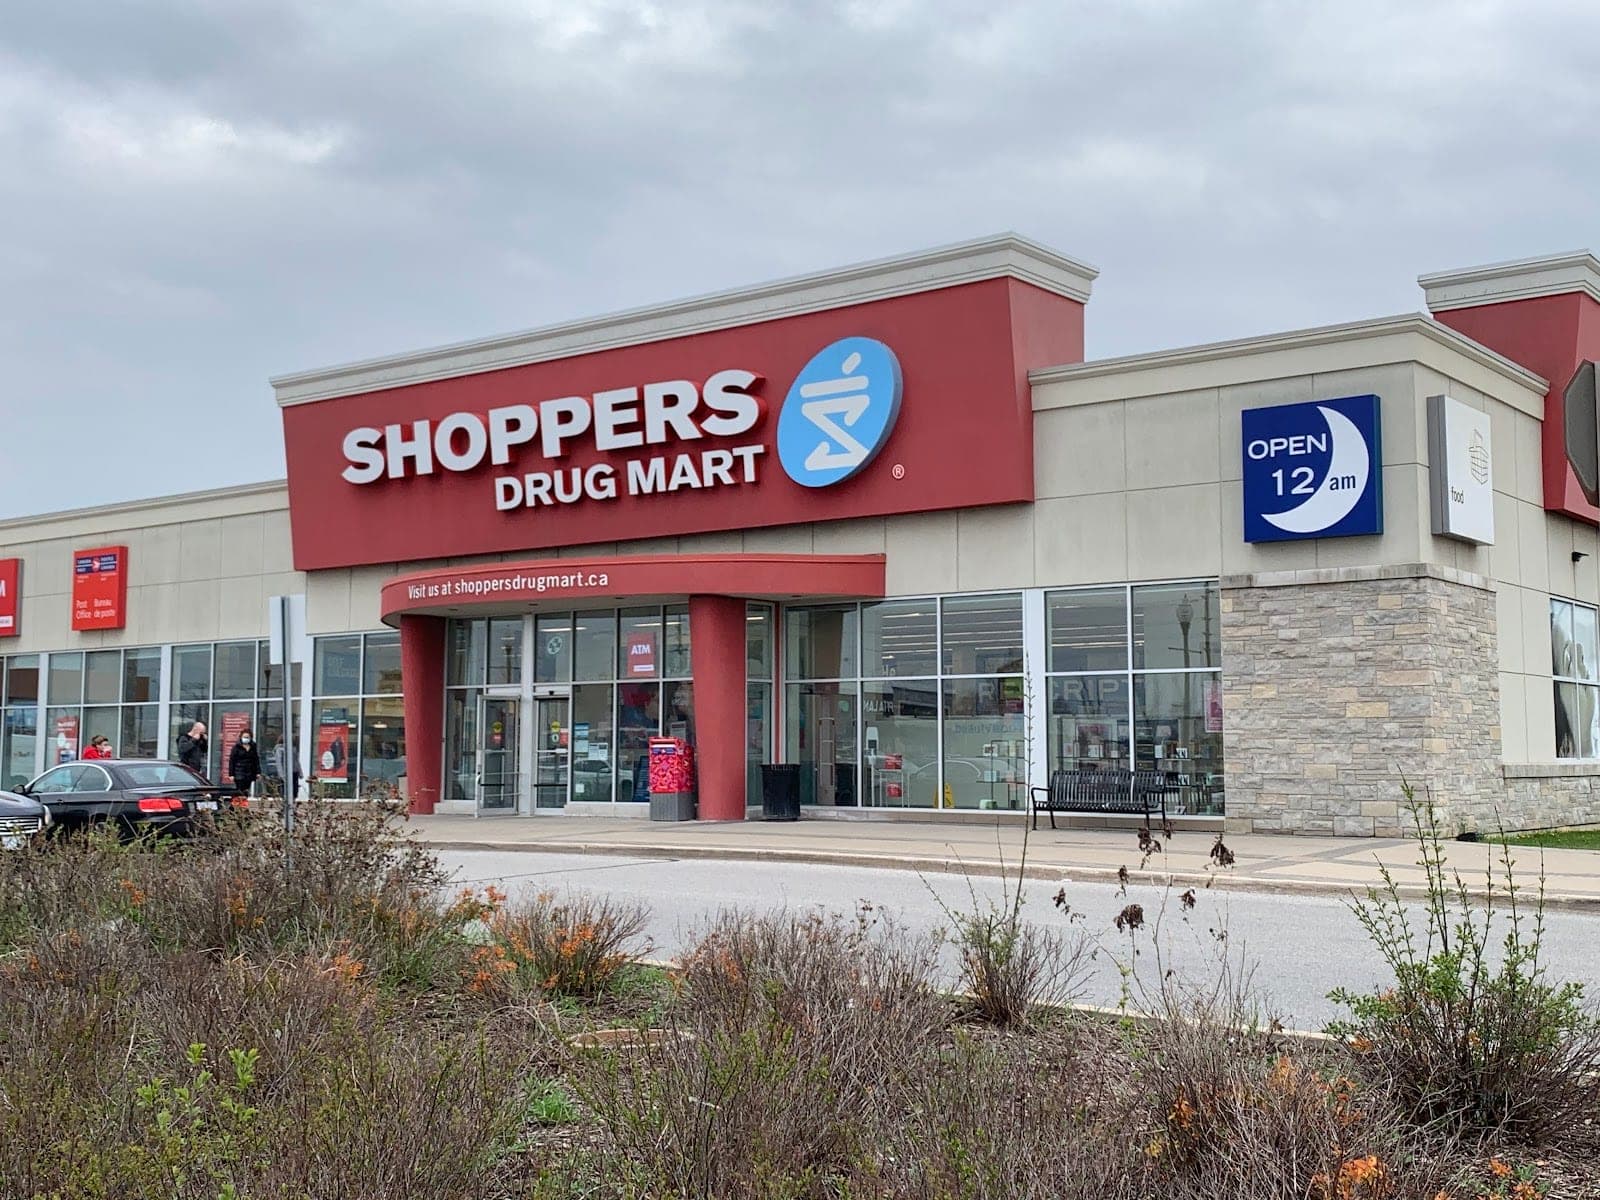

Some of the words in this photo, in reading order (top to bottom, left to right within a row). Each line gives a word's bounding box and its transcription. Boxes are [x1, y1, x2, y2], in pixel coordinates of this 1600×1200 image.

[341, 369, 759, 485] SHOPPERS
[1248, 433, 1326, 460] OPEN
[495, 463, 617, 511] DRUG
[627, 444, 765, 496] MART
[1272, 467, 1314, 496] 12
[1329, 475, 1356, 491] am
[1451, 485, 1464, 504] food
[408, 584, 426, 600] Visit
[428, 586, 439, 597] us
[441, 584, 452, 596] at
[455, 572, 609, 596] shoppersdrugmart.ca
[631, 644, 651, 656] ATM
